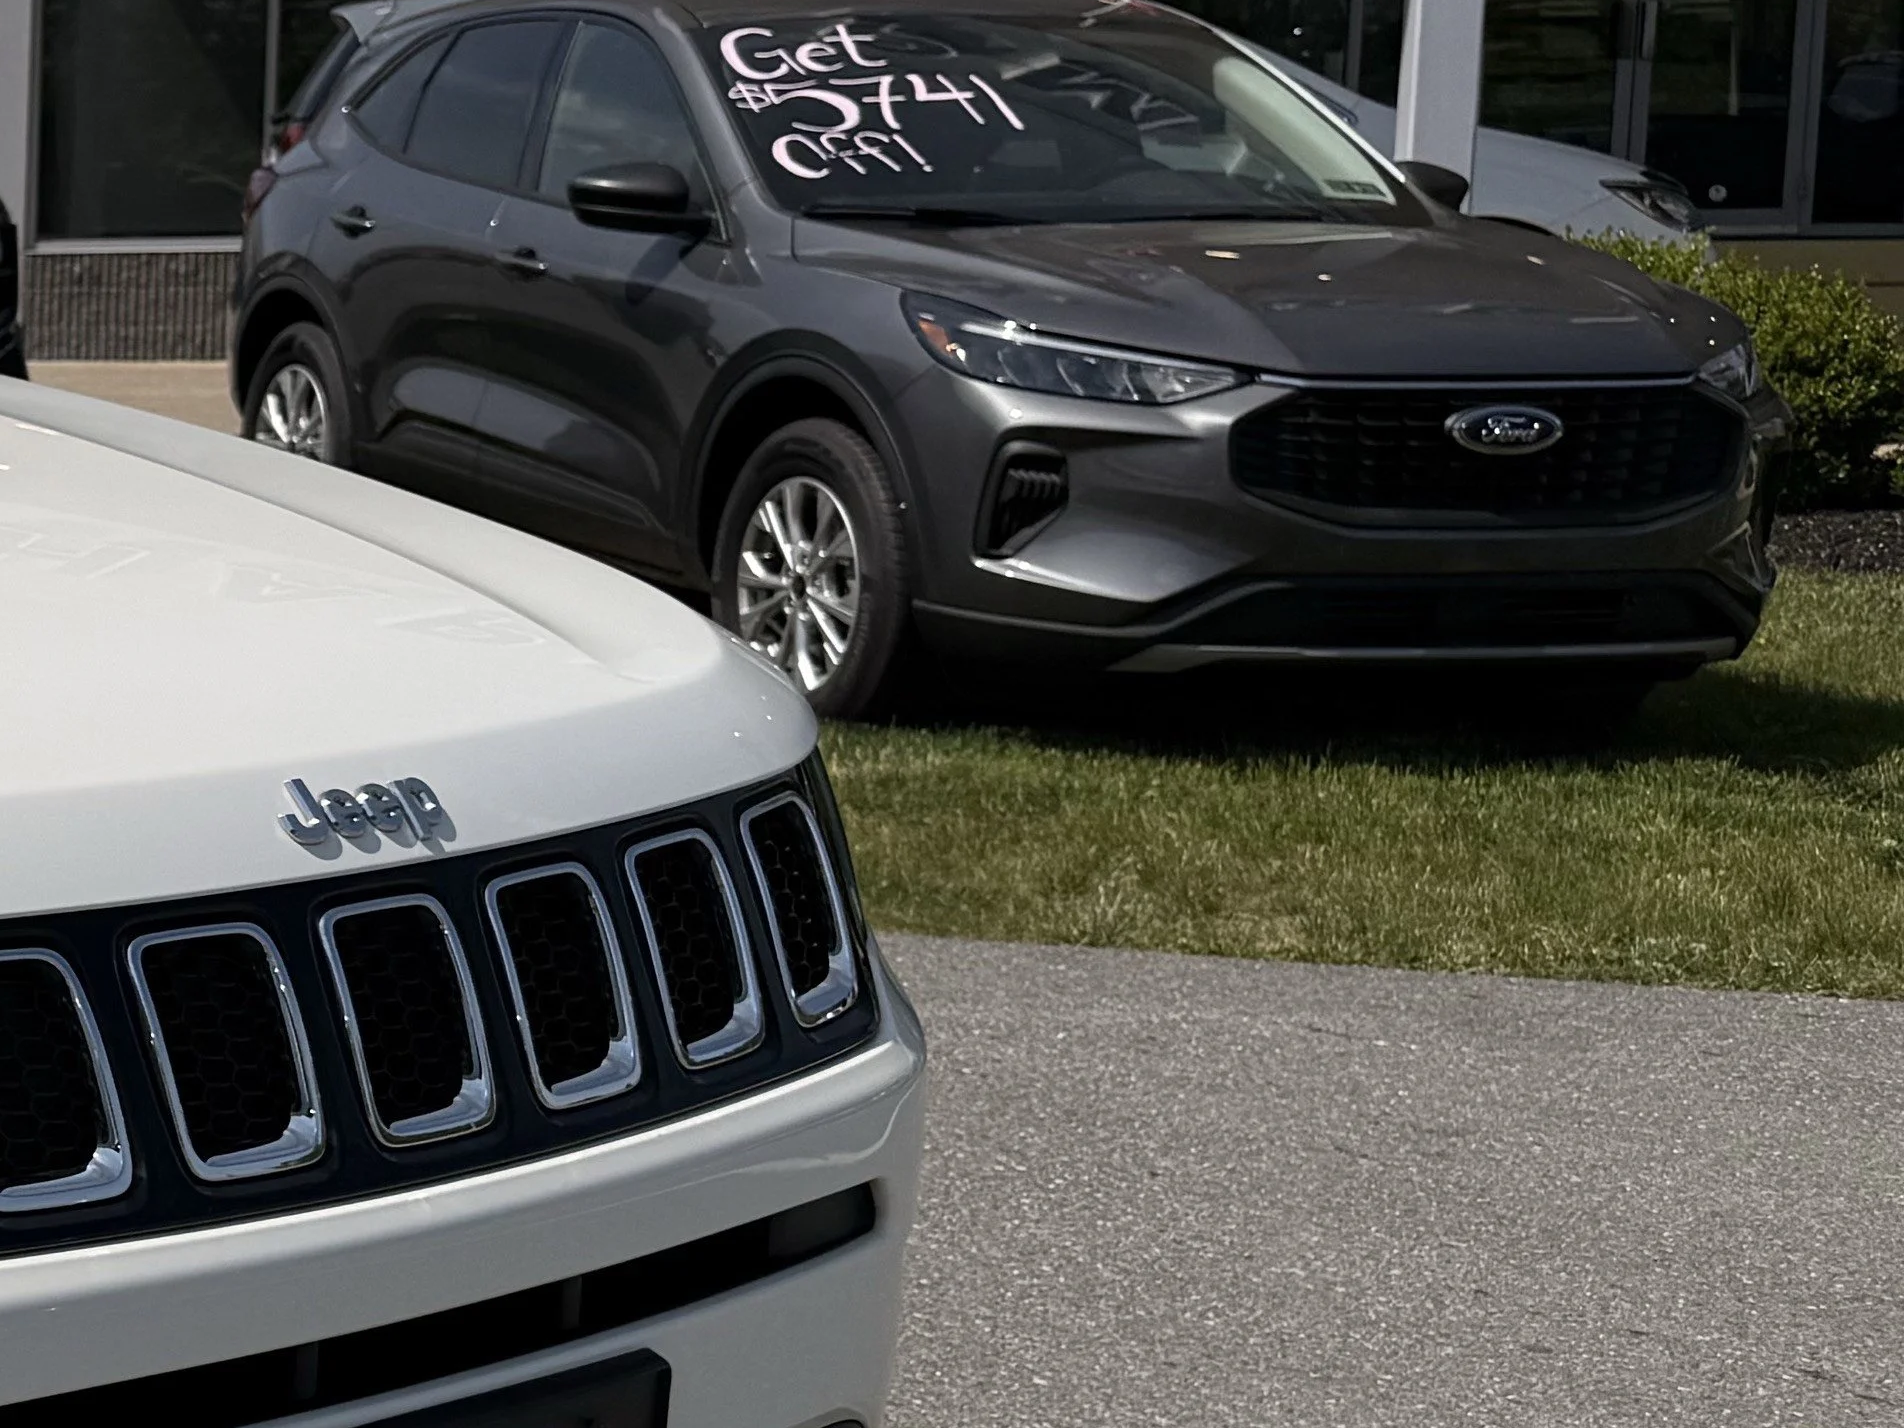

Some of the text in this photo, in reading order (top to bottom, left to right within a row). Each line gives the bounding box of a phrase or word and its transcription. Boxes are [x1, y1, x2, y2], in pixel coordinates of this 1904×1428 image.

[719, 23, 888, 81] Get
[728, 73, 1025, 134] $5741
[771, 130, 934, 180] Off!
[277, 776, 446, 846] Jeep
